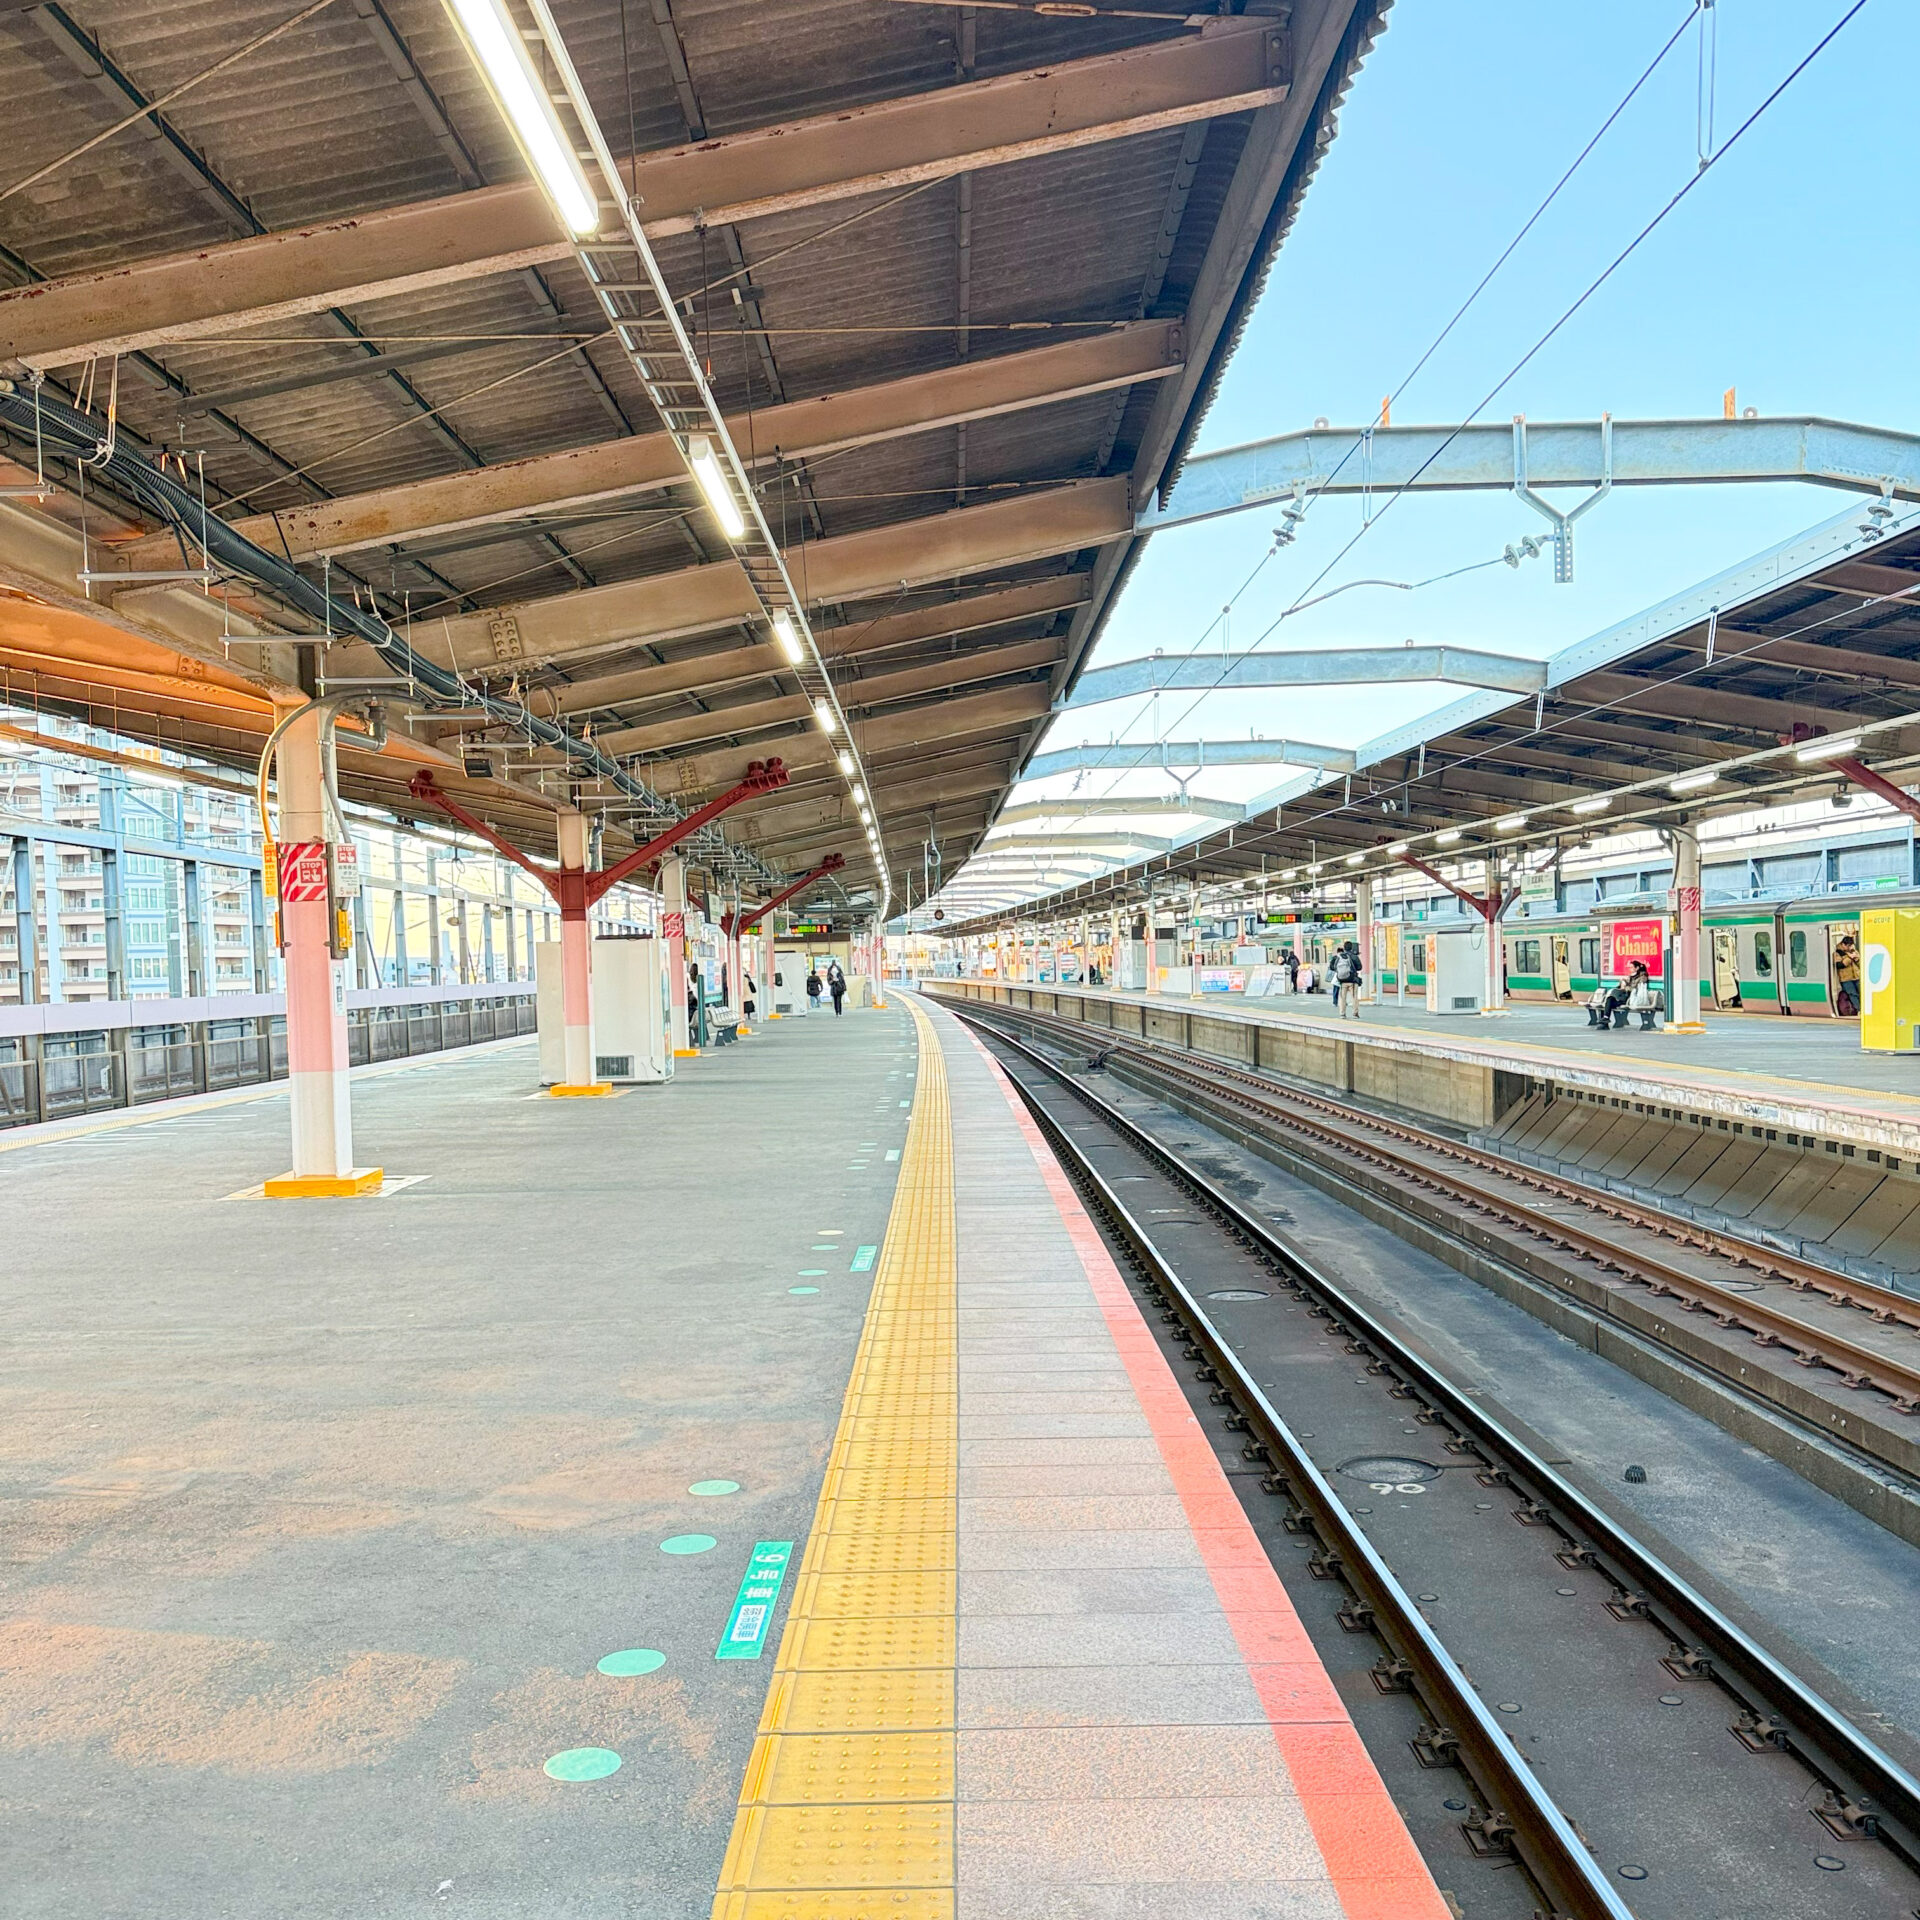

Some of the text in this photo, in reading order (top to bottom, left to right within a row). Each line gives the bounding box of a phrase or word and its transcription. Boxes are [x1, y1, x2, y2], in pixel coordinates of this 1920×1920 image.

[1615, 934, 1658, 956] Ghana
[1369, 1482, 1426, 1495] 90
[744, 1553, 785, 1598] 9号車
